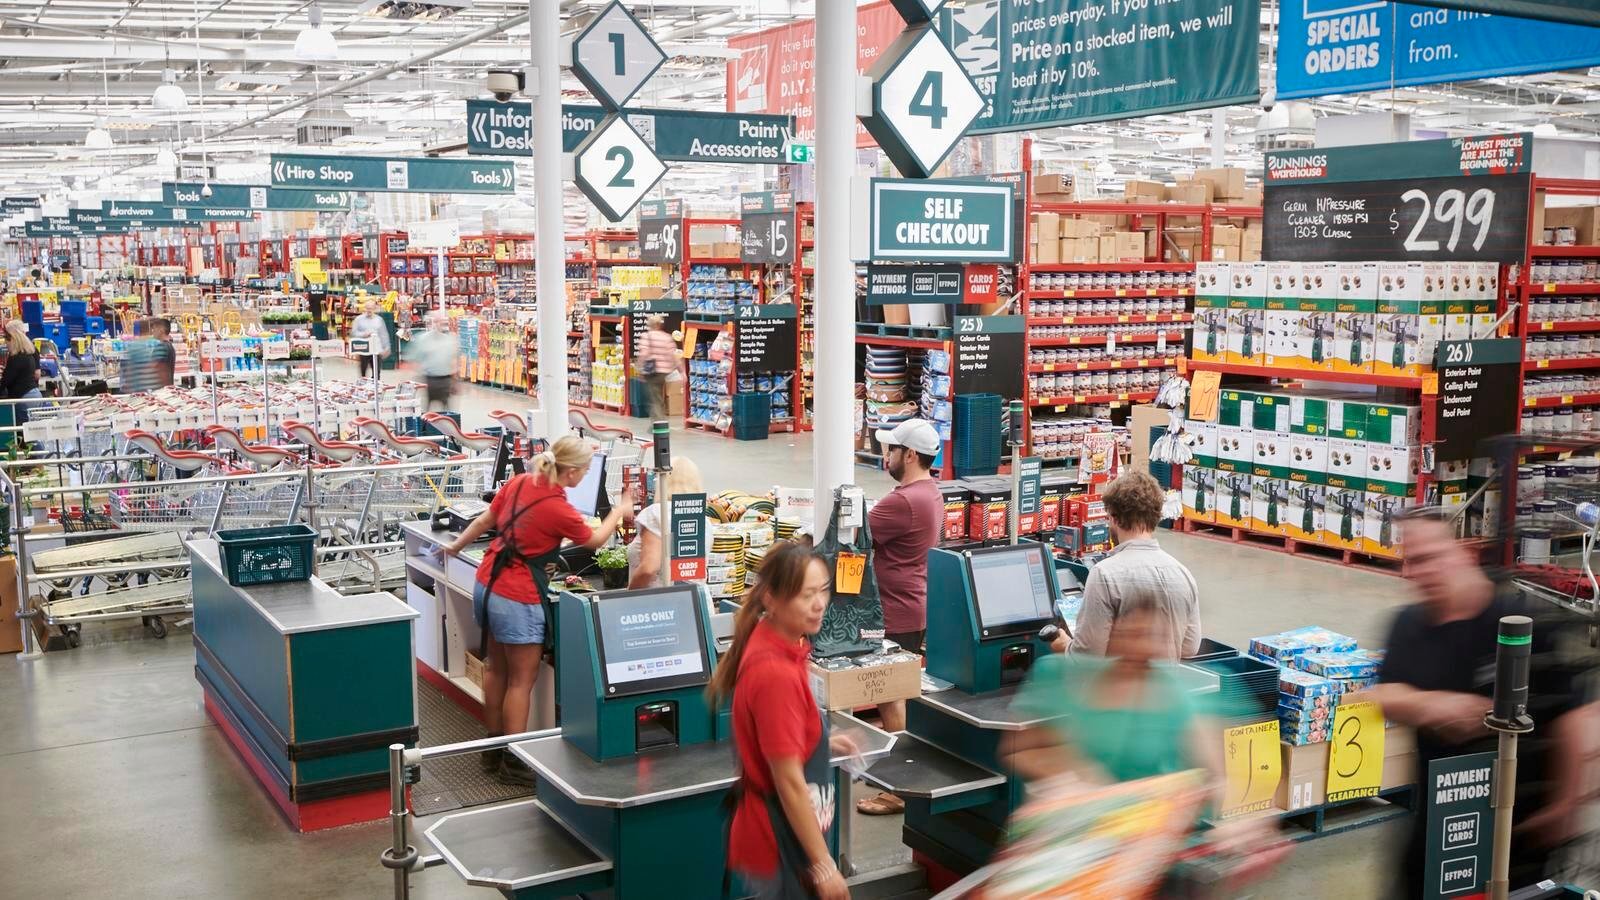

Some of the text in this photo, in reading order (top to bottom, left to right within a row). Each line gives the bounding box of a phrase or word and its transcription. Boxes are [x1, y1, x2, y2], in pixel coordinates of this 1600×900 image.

[1012, 16, 1046, 38] prices
[1049, 2, 1106, 26] everyday.
[1124, 0, 1148, 16] you
[1410, 9, 1448, 28] and
[1012, 5, 1232, 63] Price on a stocked item, we will
[1307, 16, 1380, 46] SPECIAL
[781, 40, 800, 53] Have
[1409, 40, 1459, 64] from.
[608, 33, 625, 76] 1
[1305, 42, 1379, 75] ORDERS
[781, 61, 790, 74] do
[793, 60, 797, 72] it
[1012, 60, 1100, 88] beat it by 10%.
[908, 70, 948, 129] 4
[739, 120, 777, 139] Paint
[690, 138, 778, 158] Accessories
[1461, 140, 1494, 150] LOWEST
[1495, 137, 1523, 148] PRICES
[1461, 148, 1514, 160] ARE JUST THE
[605, 146, 635, 187] 2
[1269, 155, 1327, 170] BUNNINGS
[287, 166, 353, 182] Hire Shop
[471, 170, 501, 184] Tools
[1272, 167, 1322, 179] warehouse
[174, 191, 200, 202] Tools
[315, 194, 338, 204] Tools
[205, 208, 245, 217] Hardware
[924, 197, 963, 220] SELF
[77, 214, 102, 224] Fixings
[1333, 213, 1353, 224] 1885
[1355, 213, 1369, 223] PSI
[896, 222, 989, 245] CHECKOUT
[1294, 226, 1317, 238] 1303
[872, 274, 907, 284] PAYMENT
[969, 274, 993, 283] CARDS
[872, 285, 907, 294] METHODS
[971, 285, 990, 294] ONLY
[633, 301, 644, 310] 23
[740, 306, 752, 317] 24
[961, 318, 974, 331] 25
[1446, 344, 1463, 362] 26
[1445, 367, 1481, 377] Exterior Paint
[1445, 381, 1478, 391] Ceiling Paint
[1444, 395, 1472, 404] Undercoat
[1443, 408, 1470, 417] Roof Paint
[678, 562, 698, 570] CARDS
[621, 610, 674, 625] CARDS ONLY
[858, 668, 893, 682] COMPACT
[1230, 722, 1278, 736] CONTAINERS
[1436, 768, 1490, 788] PAYMENT
[1328, 786, 1381, 802] CLEARANCE
[1435, 784, 1490, 804] METHODS
[1447, 820, 1475, 832] CREDIT
[1448, 830, 1473, 842] CARDS
[1445, 868, 1472, 881] EFTPOS
